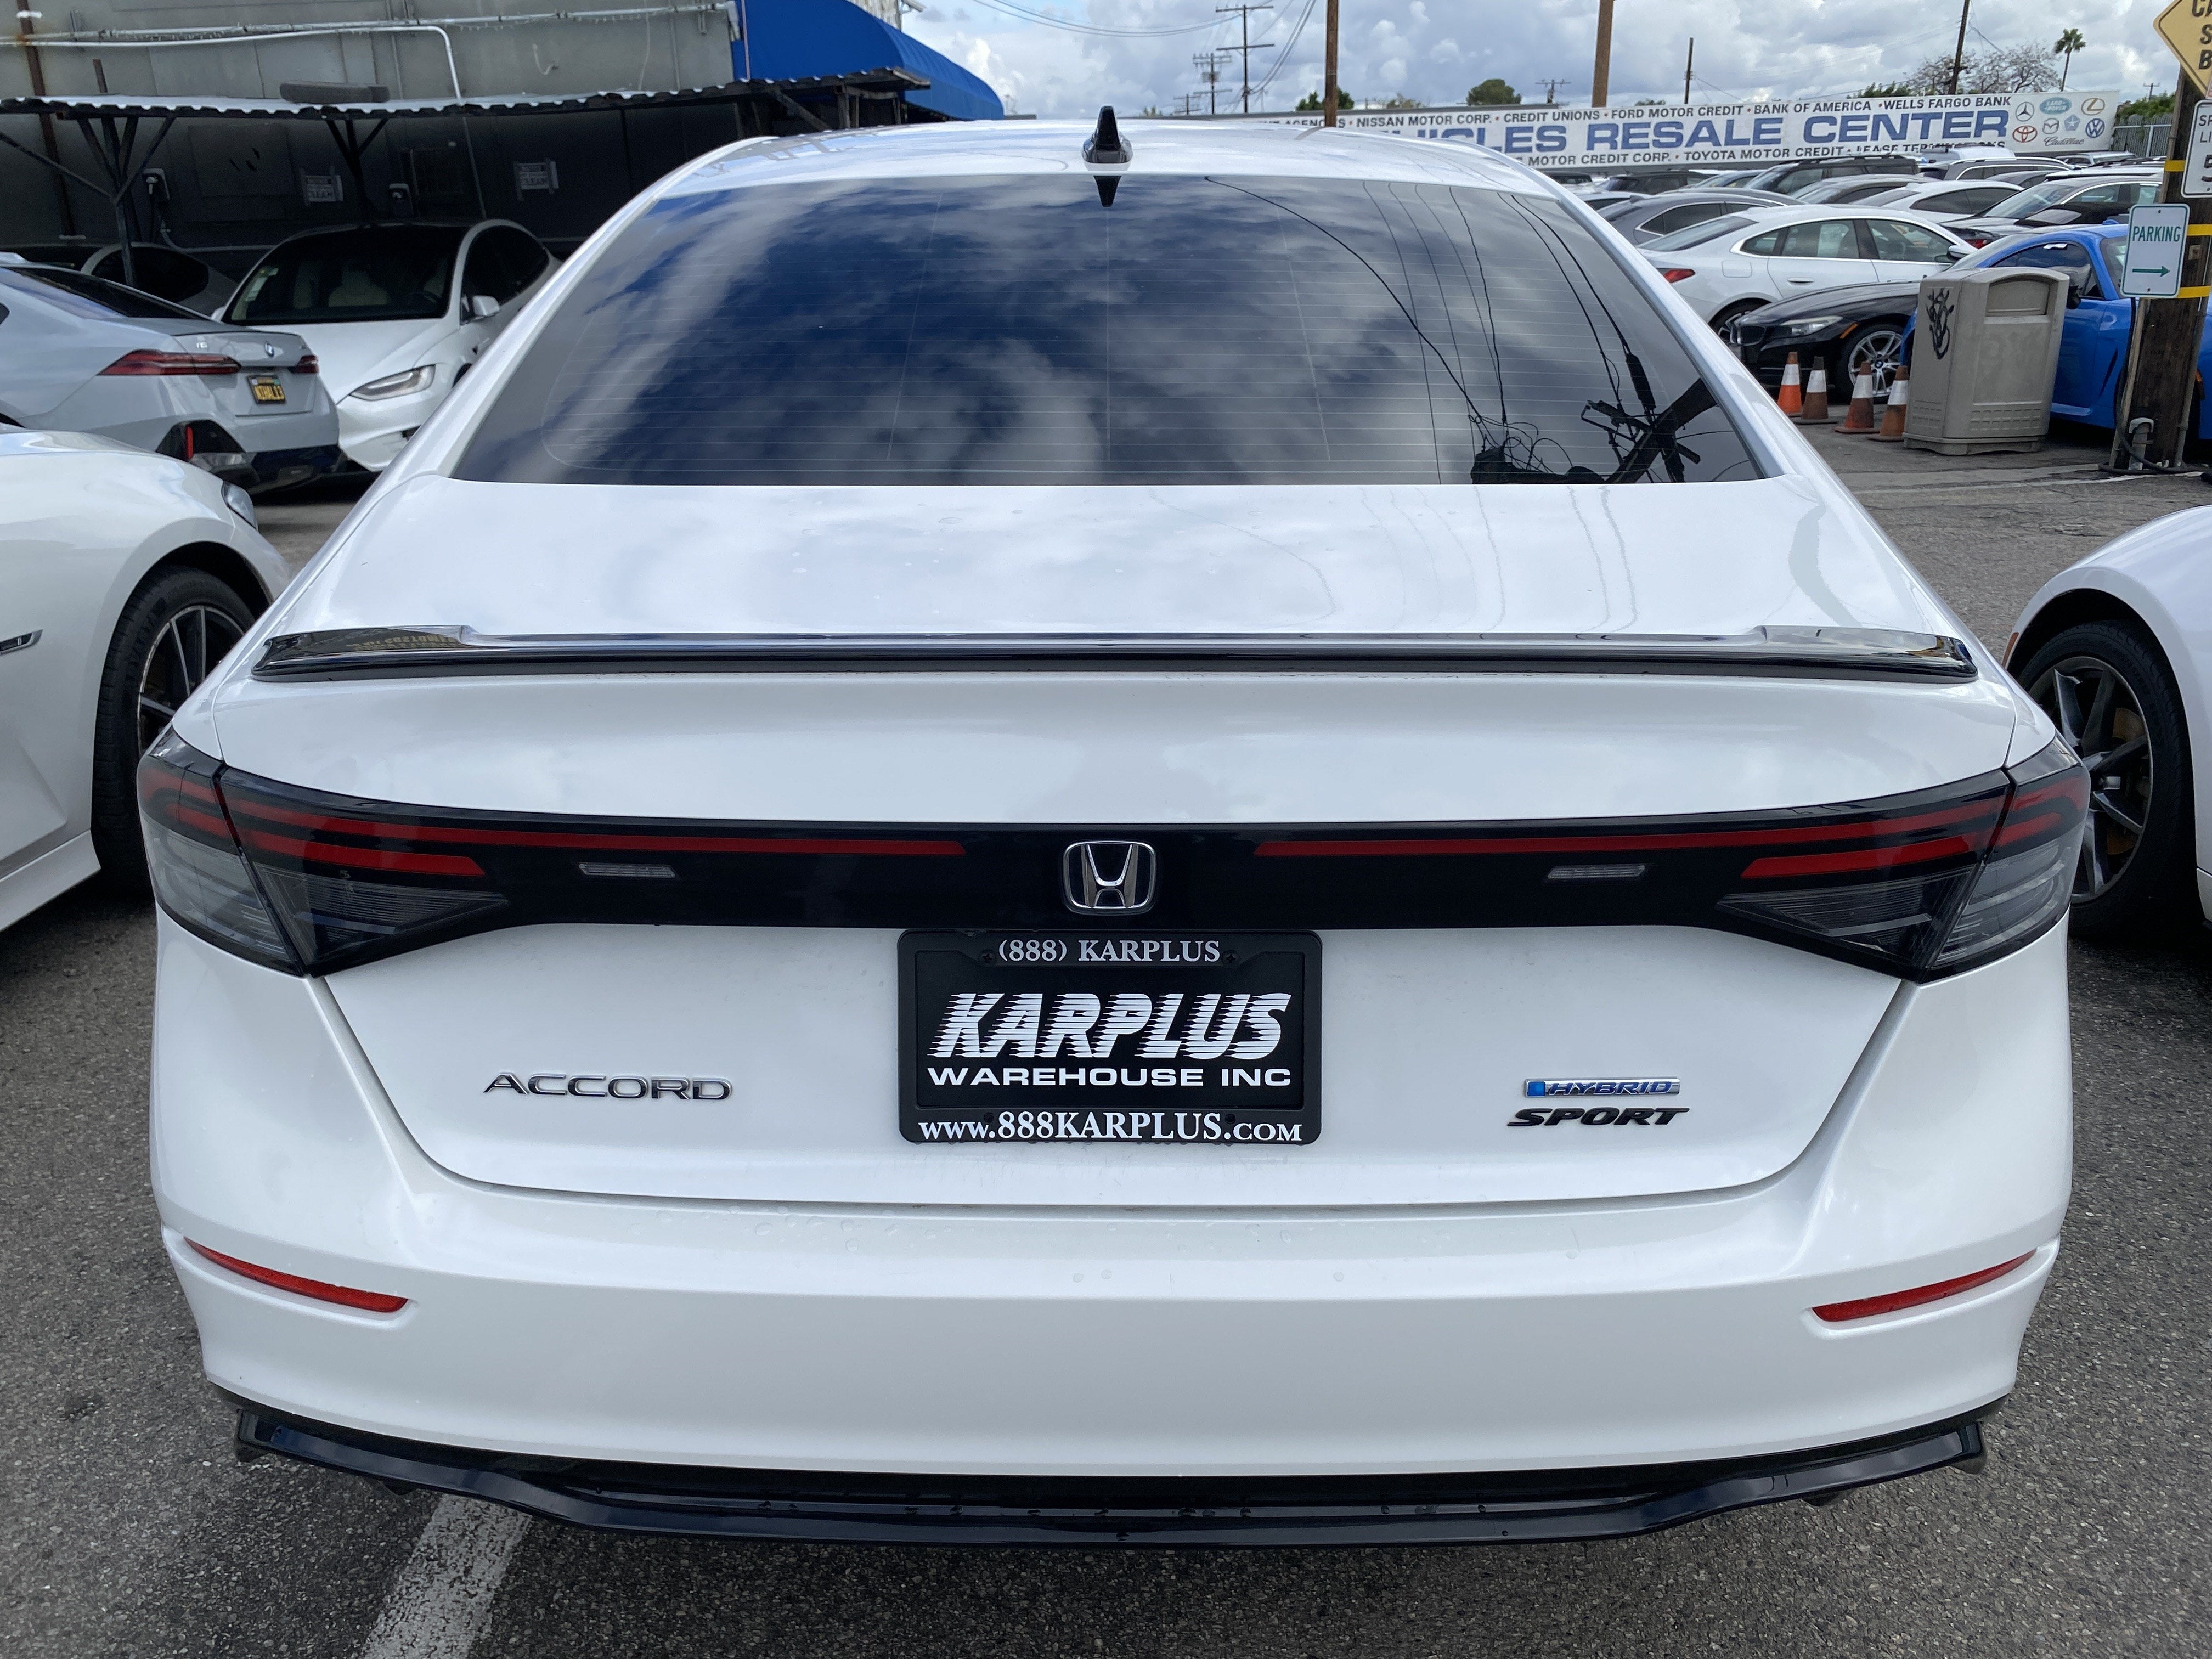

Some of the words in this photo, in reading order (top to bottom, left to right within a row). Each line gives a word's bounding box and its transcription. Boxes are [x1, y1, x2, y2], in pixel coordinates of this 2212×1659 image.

[1357, 116, 1403, 127] NISSAN
[1408, 115, 1452, 126] MOTOR
[1457, 114, 1492, 124] CORP.
[1504, 112, 1548, 122] CREDIT
[1552, 110, 1600, 121] UNIONS
[1611, 109, 1644, 119] FORD
[1648, 107, 1694, 117] MOTOR
[1698, 105, 1744, 116] CREDIT
[1754, 104, 1789, 114] BANK
[1793, 103, 1810, 112] OF
[1813, 101, 1871, 112] AMERICA
[1883, 99, 1924, 110] WELLS
[1928, 97, 1971, 109] FARGO
[1975, 96, 2012, 107] BANK
[1586, 117, 1784, 151] RESALE
[1803, 110, 2009, 144] CENTER
[1528, 155, 1576, 166] MOTOR
[1581, 153, 1628, 164] CREDIT
[1633, 152, 1672, 162] CORP.
[1684, 150, 1736, 161] TOYOTA
[1740, 148, 1790, 159] MOTOR
[1795, 146, 1844, 157] CREDIT
[2132, 224, 2181, 242] PARKING
[997, 939, 1068, 962] (888)
[1078, 939, 1220, 962] KARPLUS
[927, 992, 1292, 1060] KARPLUS
[483, 1071, 733, 1101] ACCORD
[927, 1068, 1204, 1087] WAREHOUSE
[1221, 1068, 1291, 1087] INC
[1549, 1080, 1673, 1096] HYBRID
[1506, 1107, 1690, 1127] SPORT
